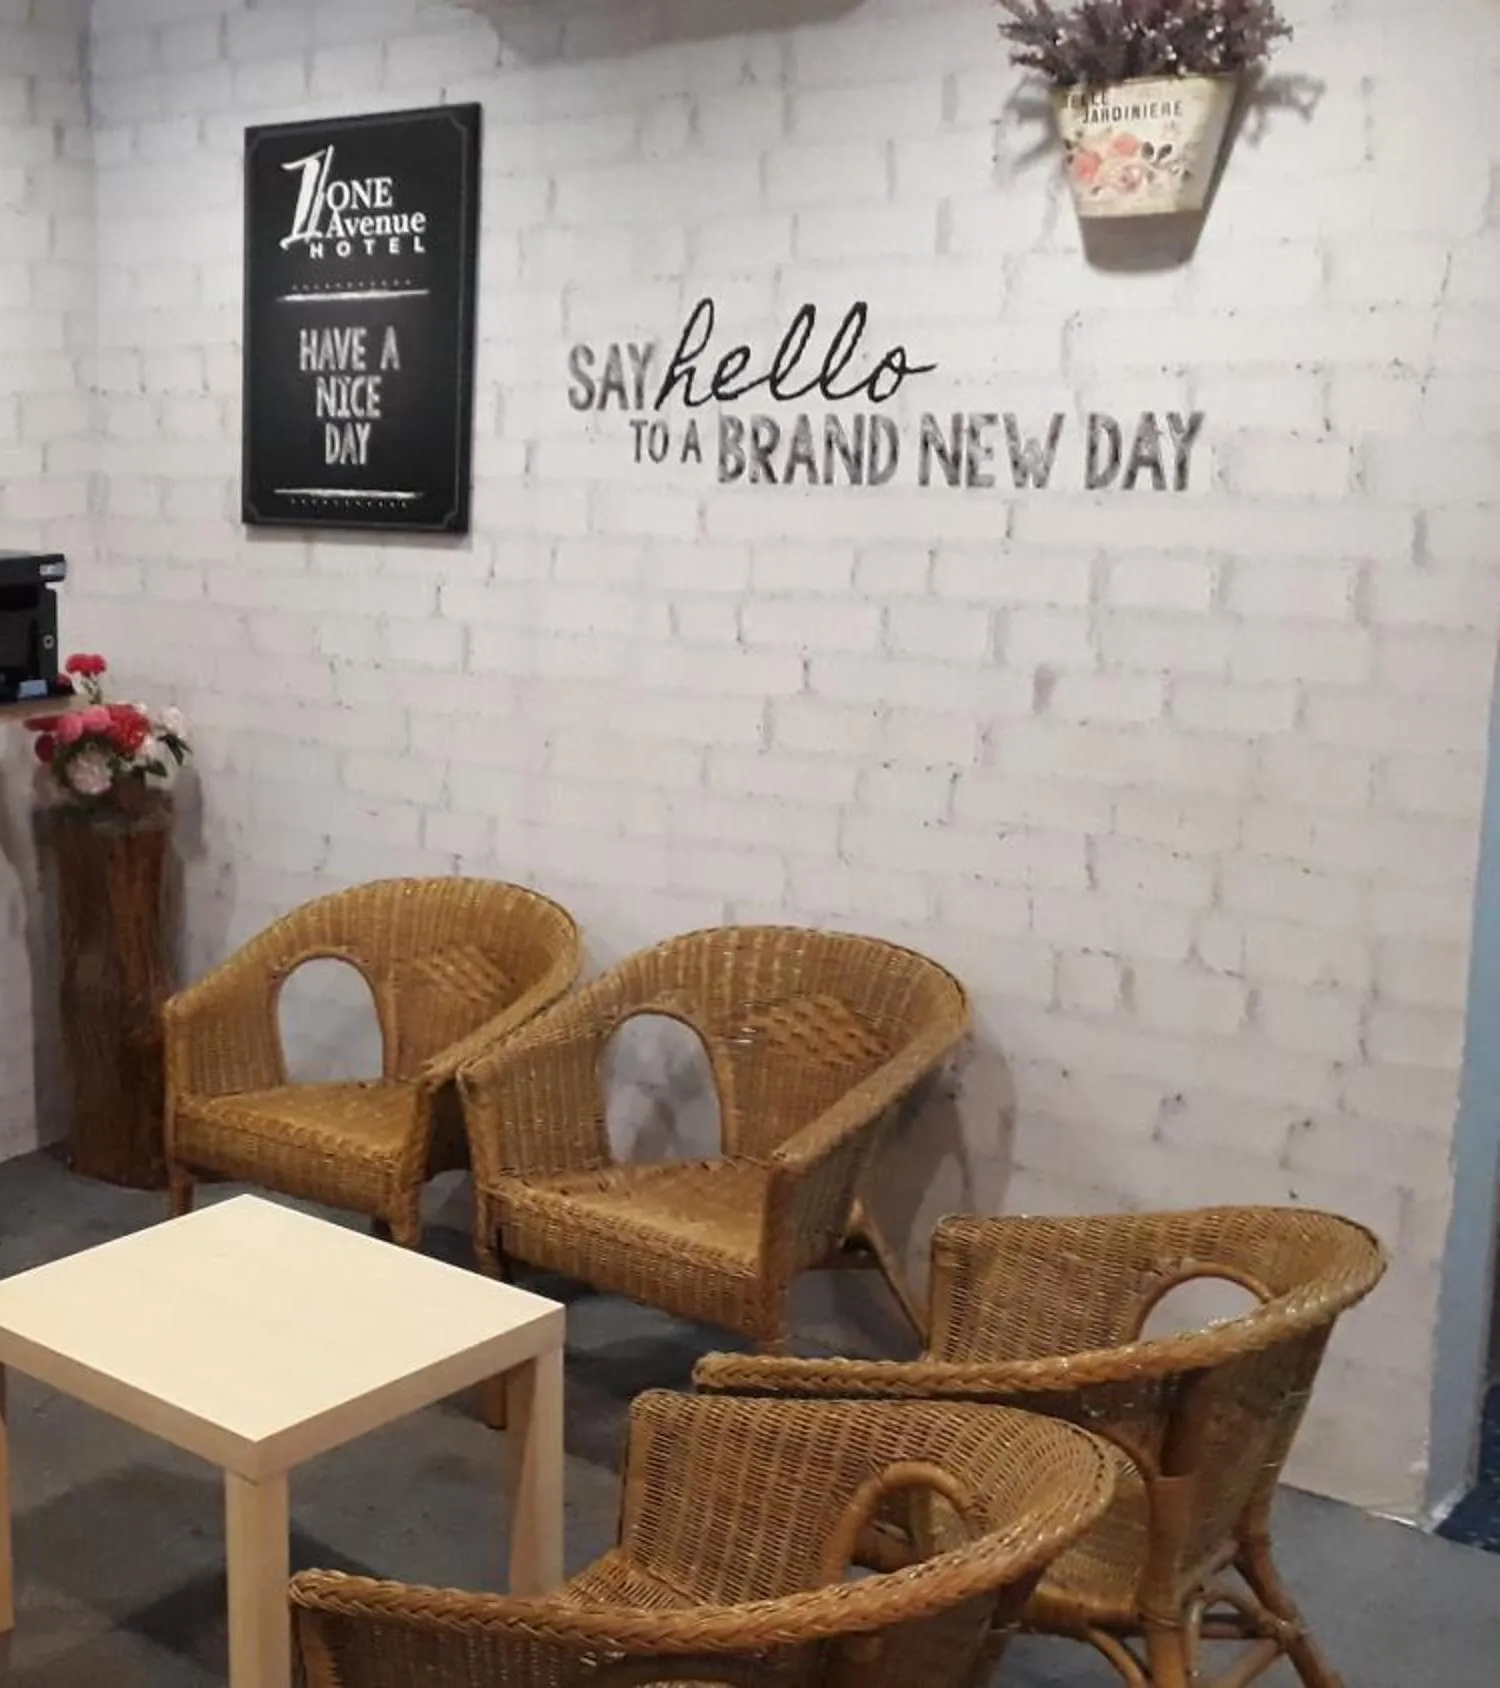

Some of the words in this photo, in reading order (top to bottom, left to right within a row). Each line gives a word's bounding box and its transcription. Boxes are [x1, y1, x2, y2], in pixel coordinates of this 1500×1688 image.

[326, 176, 394, 211] ONE
[325, 210, 427, 239] Avenue
[309, 235, 426, 259] HOTEL
[299, 327, 367, 372] HAVE
[379, 325, 401, 371] A
[567, 342, 654, 411] SAY
[654, 297, 937, 411] hello
[315, 375, 382, 418] NICE
[324, 422, 371, 465] DAY
[629, 418, 669, 463] TO
[680, 418, 702, 464] A
[717, 413, 900, 486] BRAND
[917, 412, 1065, 488] NEW
[1083, 411, 1206, 491] DAY
